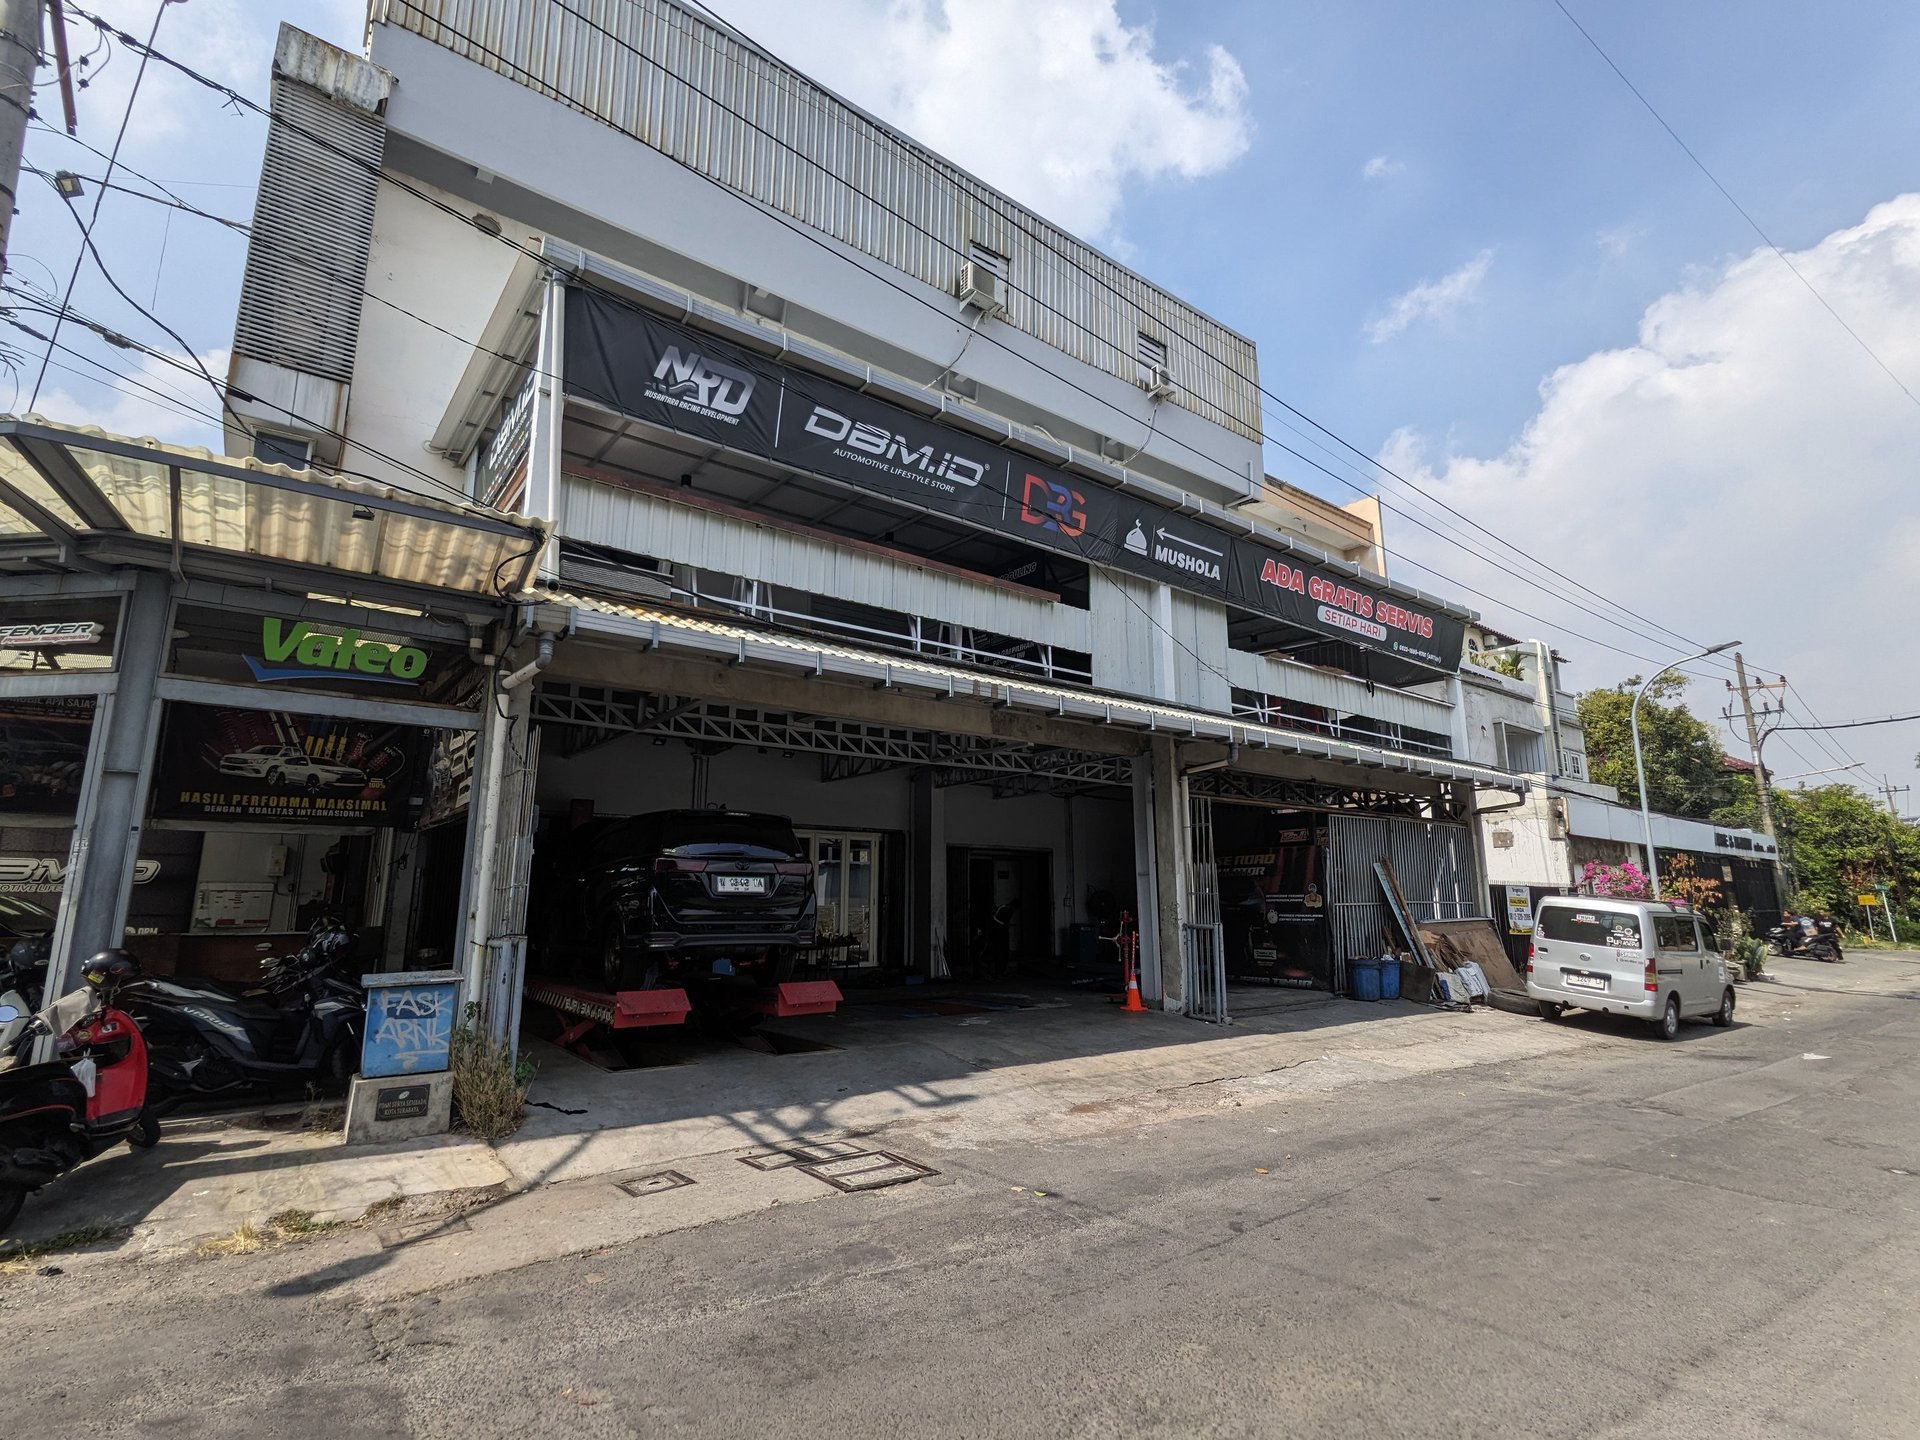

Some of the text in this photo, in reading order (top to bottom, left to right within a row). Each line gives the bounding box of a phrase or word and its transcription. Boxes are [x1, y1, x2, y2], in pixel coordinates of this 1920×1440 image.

[654, 345, 757, 415] NRD
[644, 389, 740, 426] NUSANTARA RACING DEVELOPMENT
[833, 448, 955, 493] AUTOMOTIVE LIFESTYLE STORE
[1154, 545, 1221, 581] MUSHOLA
[1260, 558, 1433, 638] ADA GRATIS SERVIS
[1324, 609, 1381, 637] SETIAP HARI
[262, 616, 428, 680] Valeo
[180, 791, 387, 811] HASIL PERFORMA MAKSIMAL
[204, 805, 242, 813] DENGAN
[248, 806, 294, 815] KUALITAS
[297, 808, 364, 818] INTERNASIONAL
